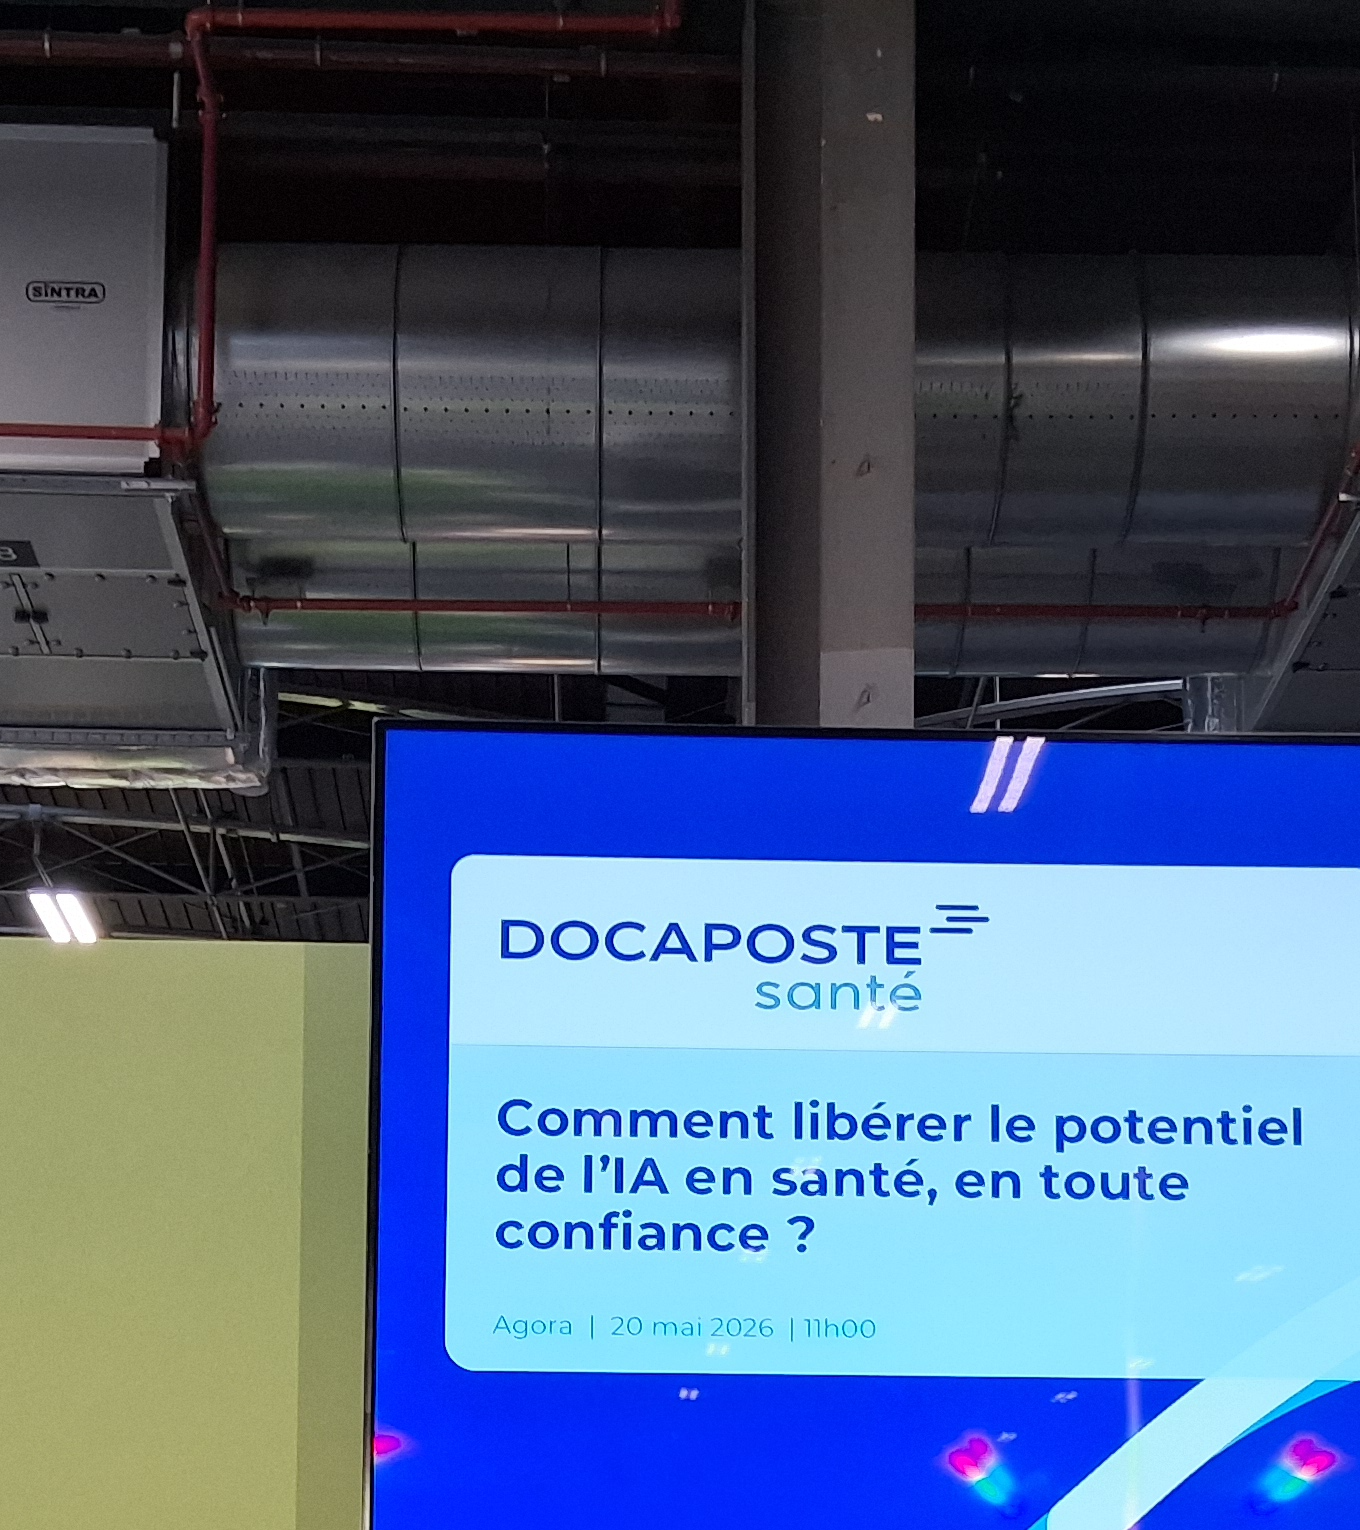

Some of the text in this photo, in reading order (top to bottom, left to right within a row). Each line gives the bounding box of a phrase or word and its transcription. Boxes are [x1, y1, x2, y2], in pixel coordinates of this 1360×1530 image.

[500, 919, 922, 966] DOCAPOSTE
[754, 970, 923, 1012] santé
[497, 1098, 1303, 1154] Comment libérer le potentiel
[496, 1153, 565, 1194] de
[685, 1165, 752, 1196] en
[771, 1158, 938, 1207] santé,
[954, 1169, 1021, 1199] en
[1038, 1164, 1190, 1201] toute
[495, 1210, 815, 1253] confiance ?
[492, 1314, 573, 1340] Agora
[610, 1316, 643, 1337] 20
[652, 1316, 702, 1337] mai
[710, 1317, 775, 1338] 2026
[803, 1317, 877, 1339] 11h00
